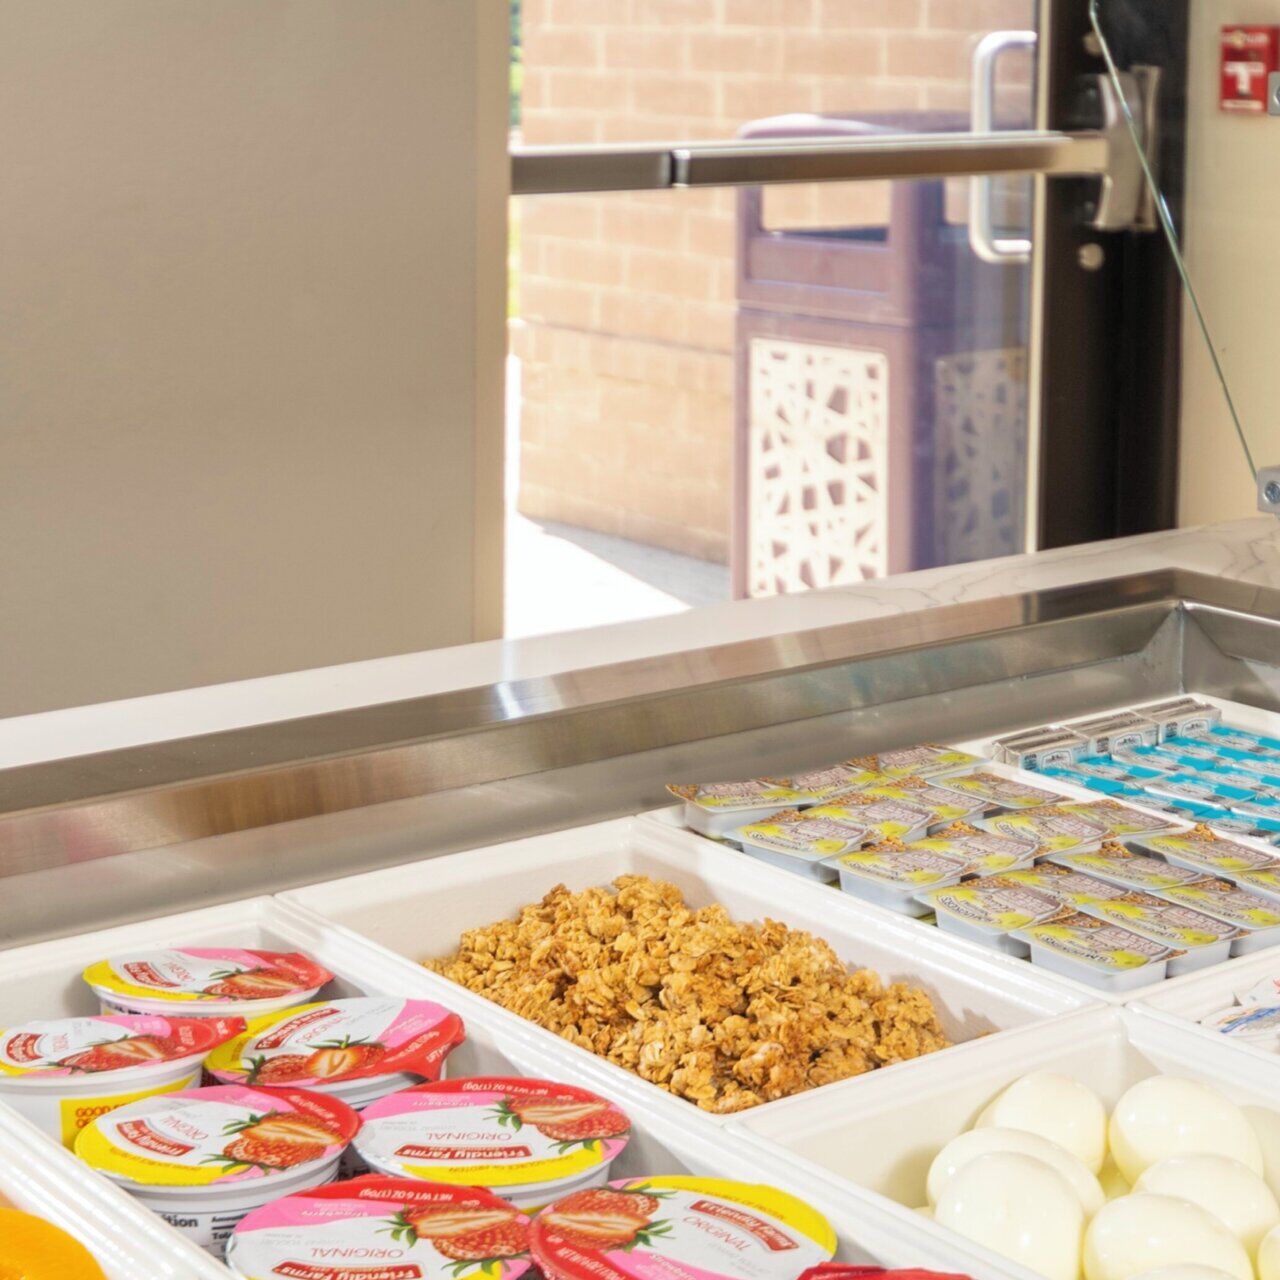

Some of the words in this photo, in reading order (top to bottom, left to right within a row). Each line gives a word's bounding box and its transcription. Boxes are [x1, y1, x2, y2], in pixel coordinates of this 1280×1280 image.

[426, 1131, 512, 1141] ORIGINAL
[403, 1148, 451, 1159] Farms
[454, 1148, 526, 1159] Friendly
[683, 1215, 752, 1250] ORIGINAL
[311, 1247, 405, 1258] ORIGINAL
